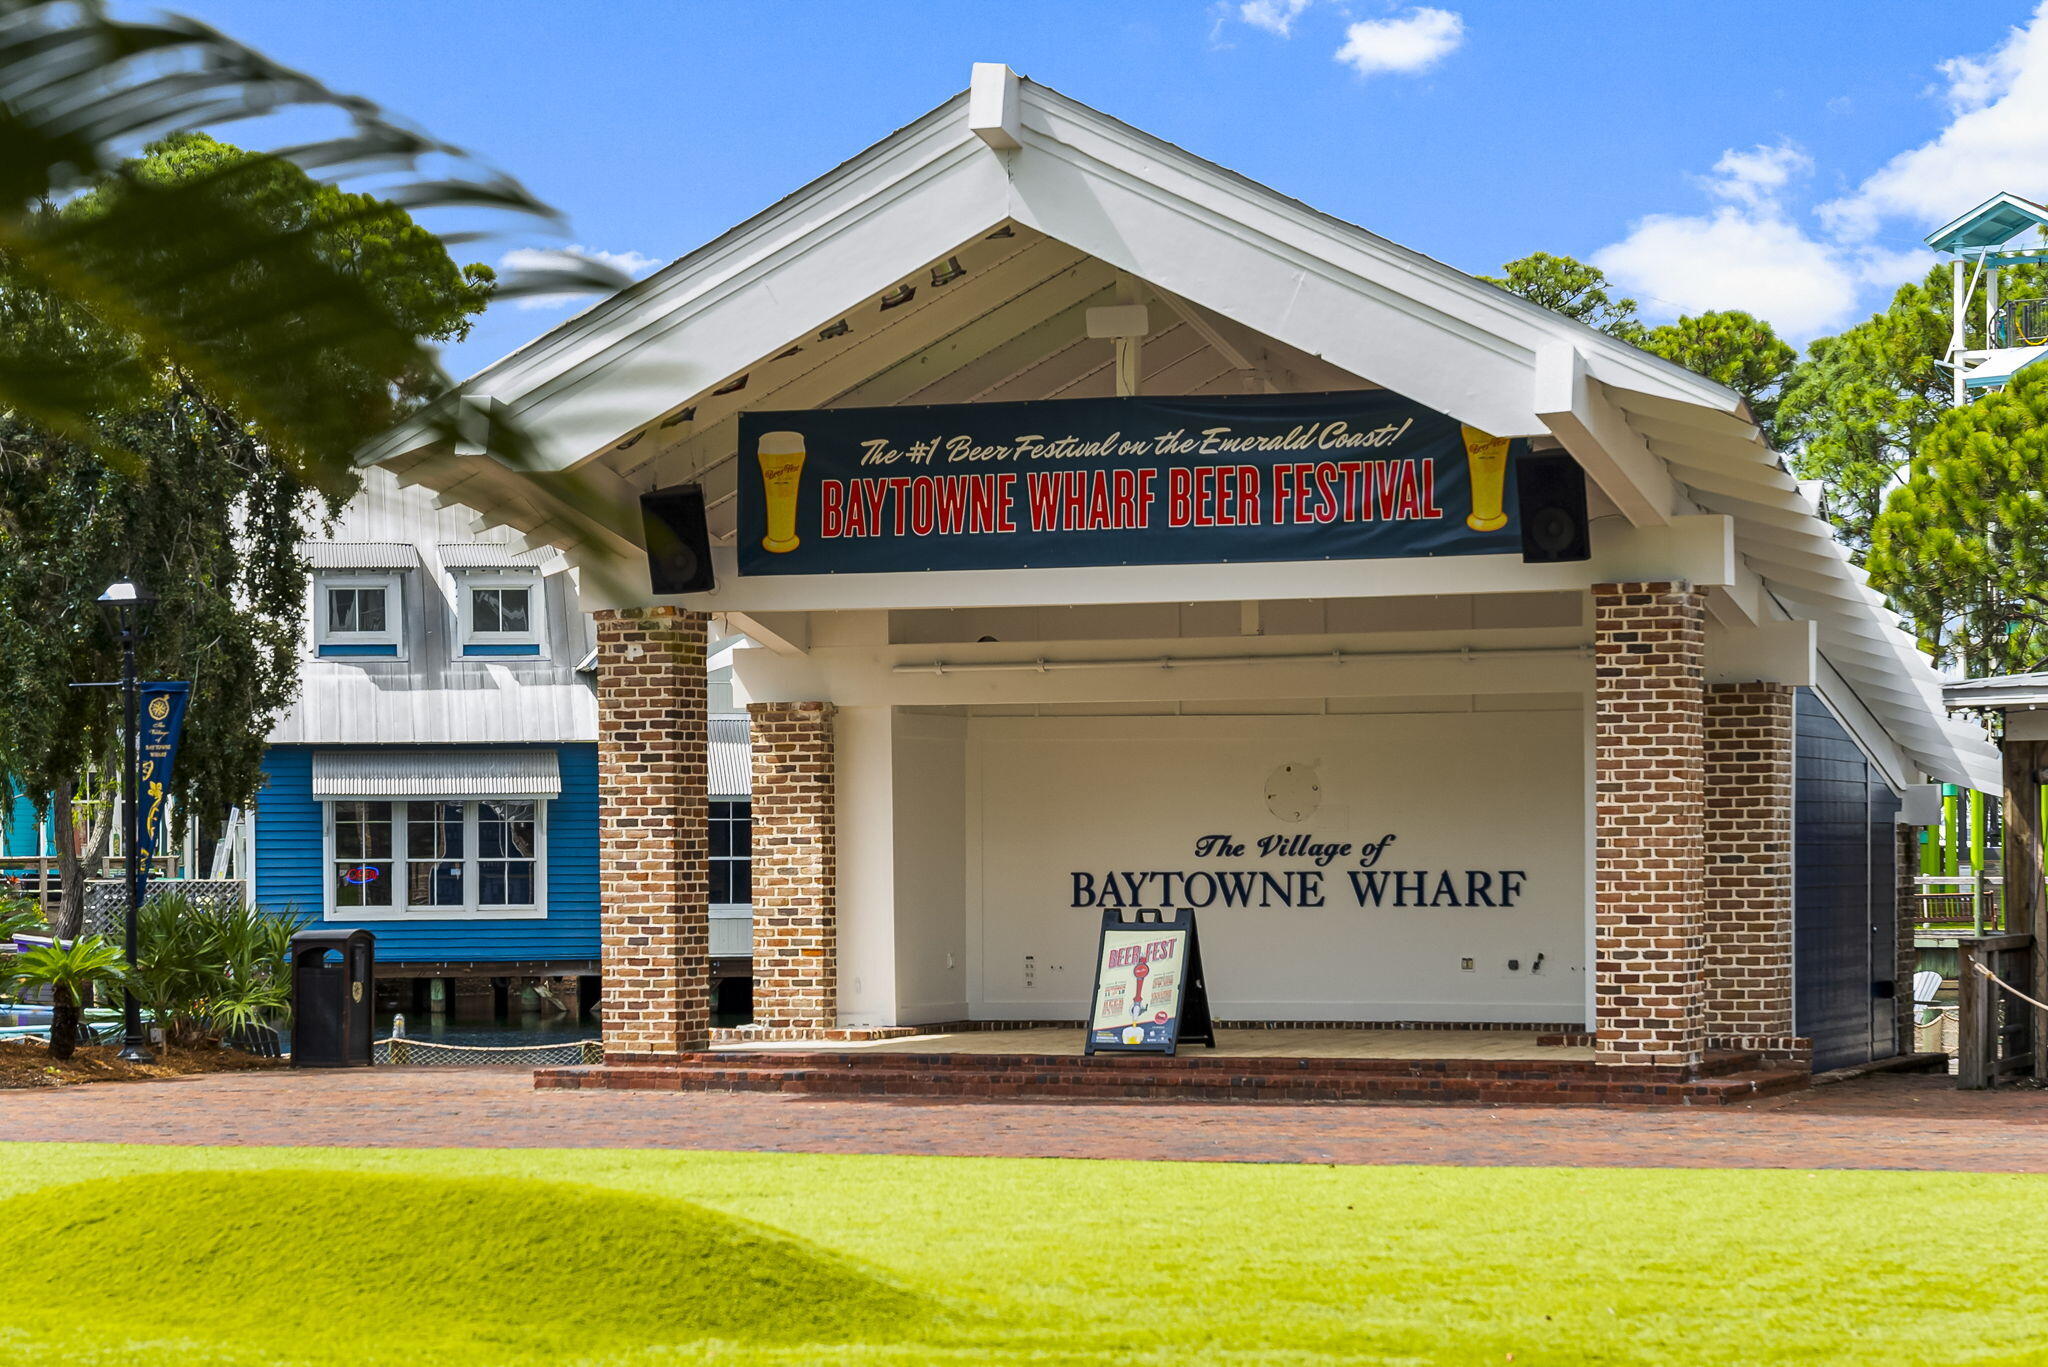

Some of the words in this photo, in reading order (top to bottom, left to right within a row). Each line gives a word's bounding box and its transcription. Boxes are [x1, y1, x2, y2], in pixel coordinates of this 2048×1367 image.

[860, 438, 903, 466] The
[906, 436, 942, 465] #1
[946, 435, 1013, 463] Beer
[1012, 431, 1121, 462] Festival
[1117, 440, 1152, 457] on
[1154, 428, 1200, 456] the
[1198, 423, 1320, 455] Emerald
[1317, 417, 1414, 450] Coast!
[820, 473, 1017, 539] BAYTOWNE
[1026, 468, 1158, 532] WHARF
[1168, 464, 1262, 528] BEER
[1272, 457, 1444, 525] FESTIVAL
[1194, 834, 1245, 858] The
[1256, 834, 1352, 867] Village
[1361, 833, 1397, 867] of
[1070, 871, 1326, 908] BAYTOWNE
[1347, 870, 1528, 908] WHARF
[1108, 945, 1142, 969] BEER
[1144, 938, 1178, 963] FEST
